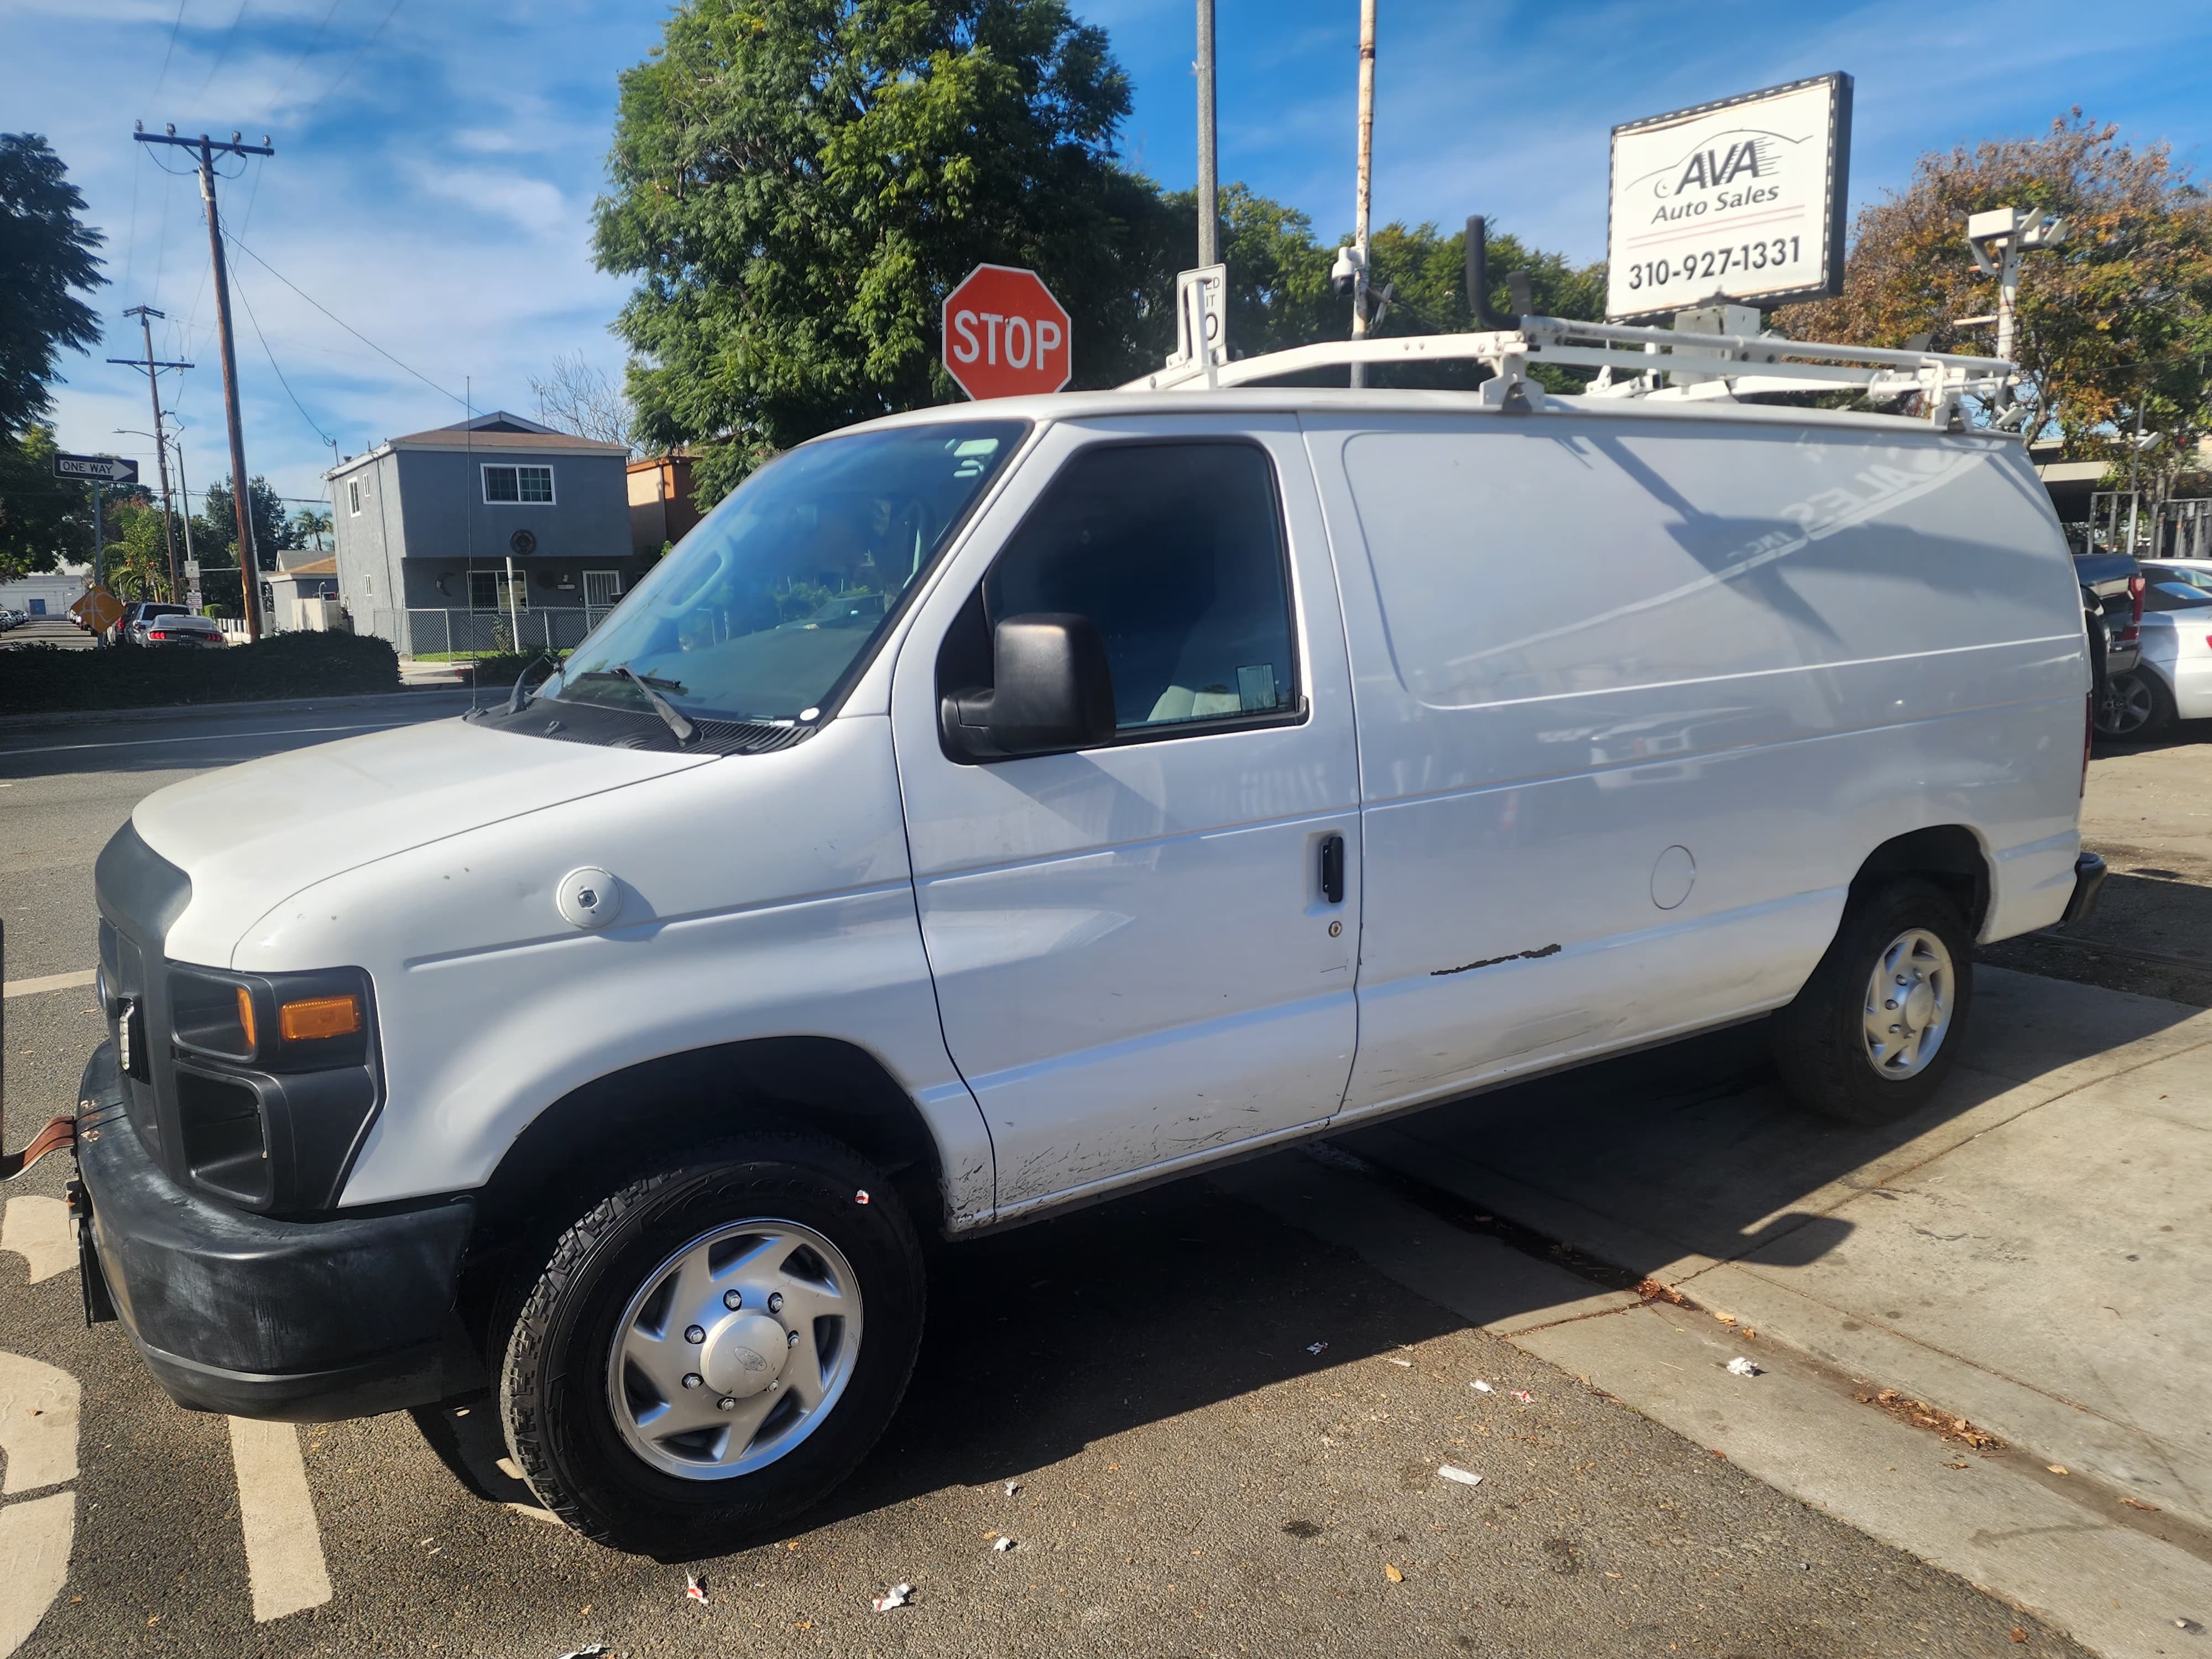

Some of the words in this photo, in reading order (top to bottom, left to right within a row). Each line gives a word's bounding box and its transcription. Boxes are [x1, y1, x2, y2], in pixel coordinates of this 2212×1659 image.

[1674, 139, 1760, 196] AVA
[1651, 200, 1708, 225] Auto
[1715, 185, 1780, 212] Sales
[1629, 235, 1801, 290] 310-927-1331
[953, 309, 1062, 371] STOP
[62, 461, 86, 472] ONE
[90, 463, 113, 475] WAY
